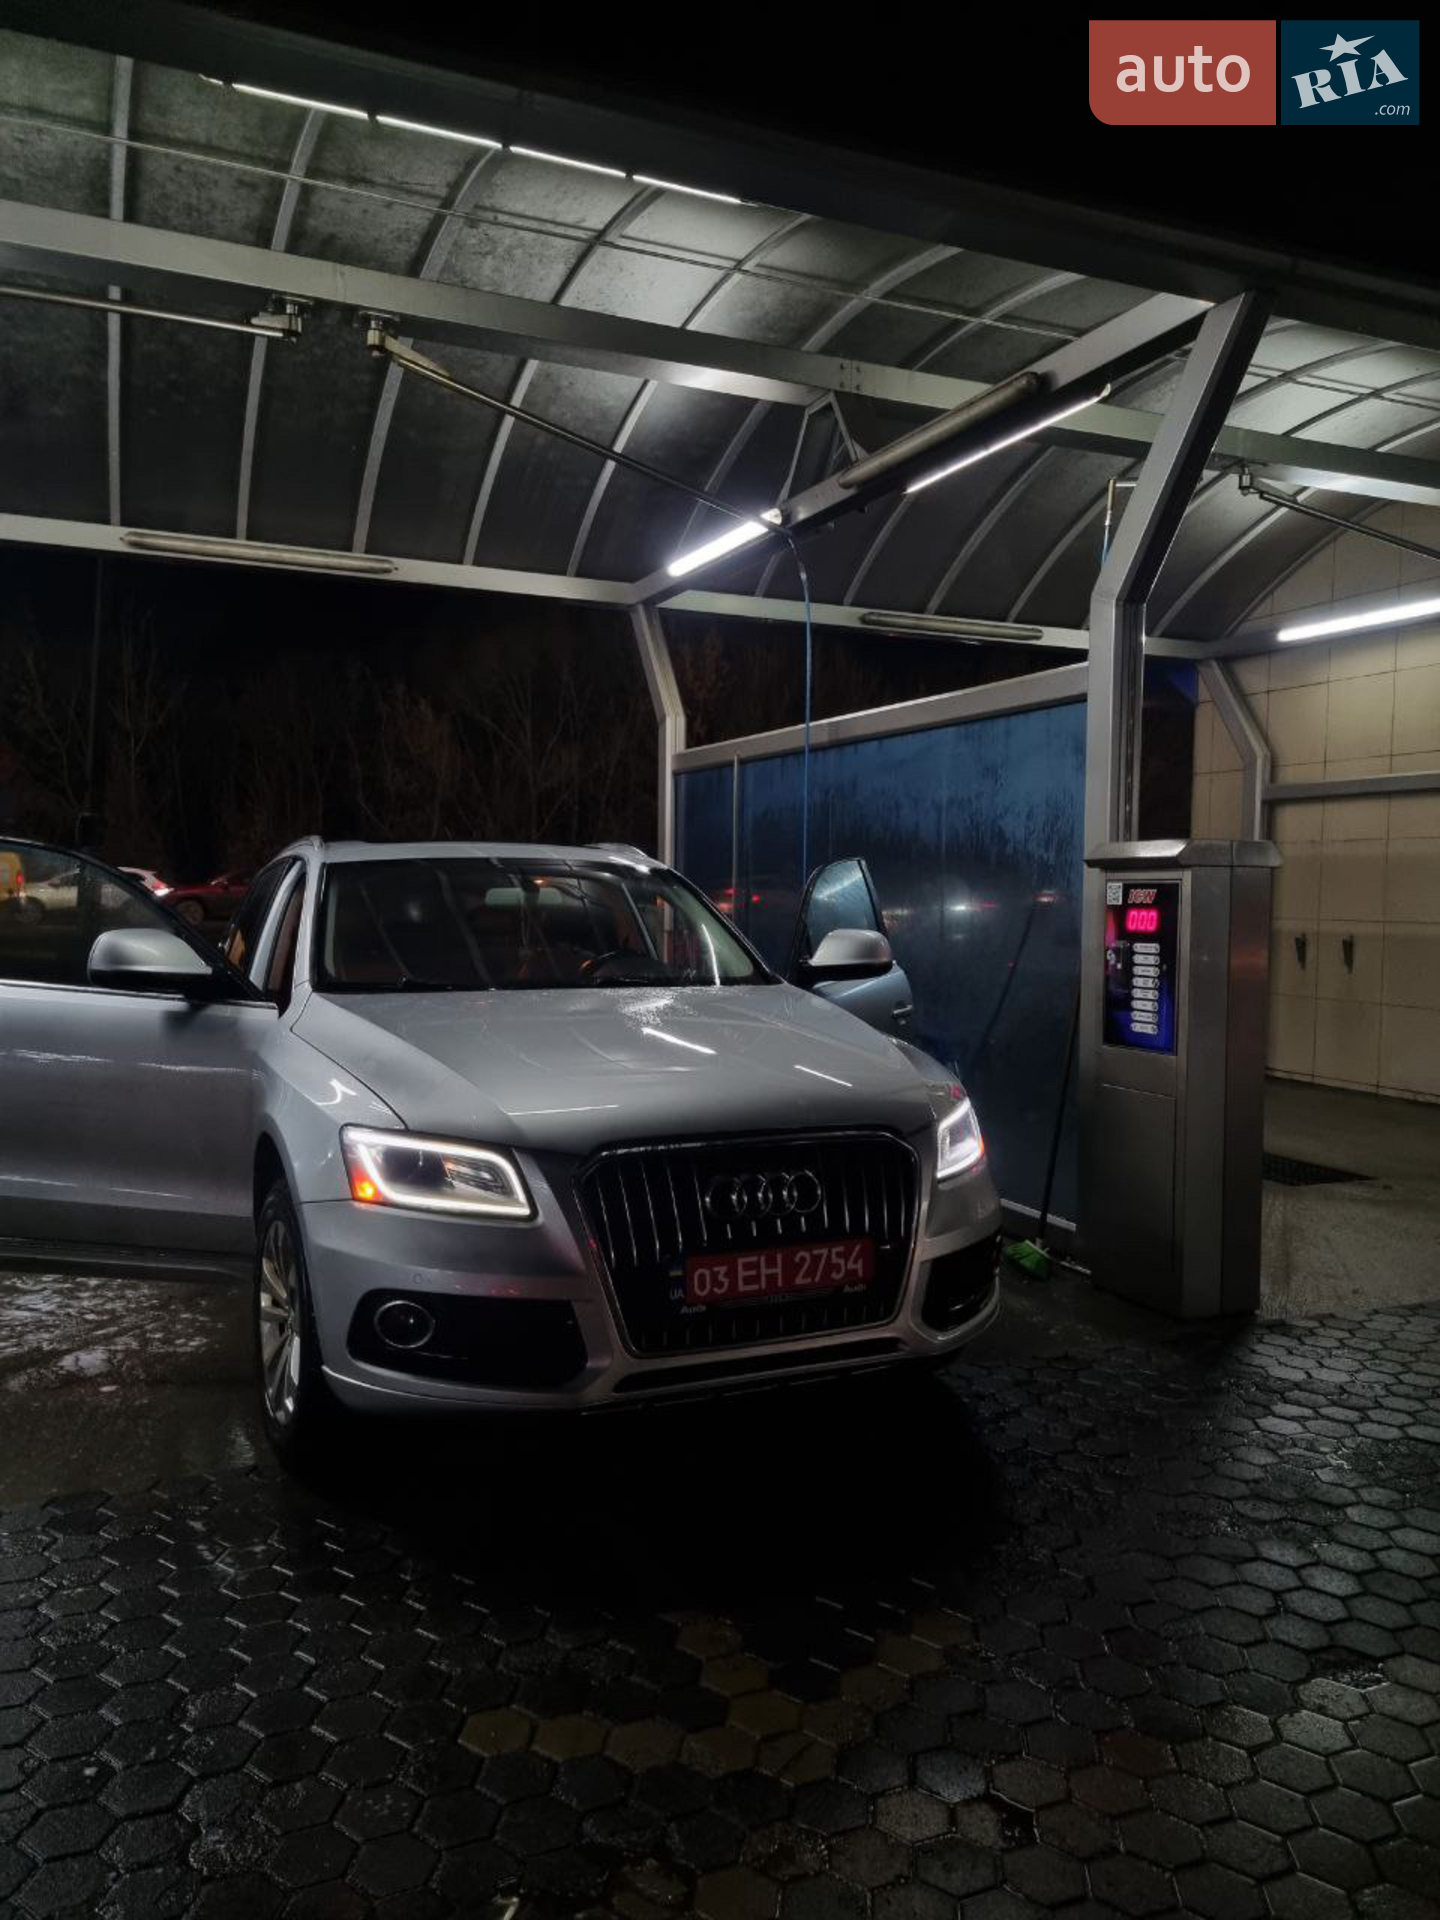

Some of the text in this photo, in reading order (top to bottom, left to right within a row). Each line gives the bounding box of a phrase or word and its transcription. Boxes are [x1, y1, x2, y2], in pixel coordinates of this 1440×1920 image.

[1127, 909, 1158, 932] 000
[693, 1244, 864, 1297] 03 EH 2754
